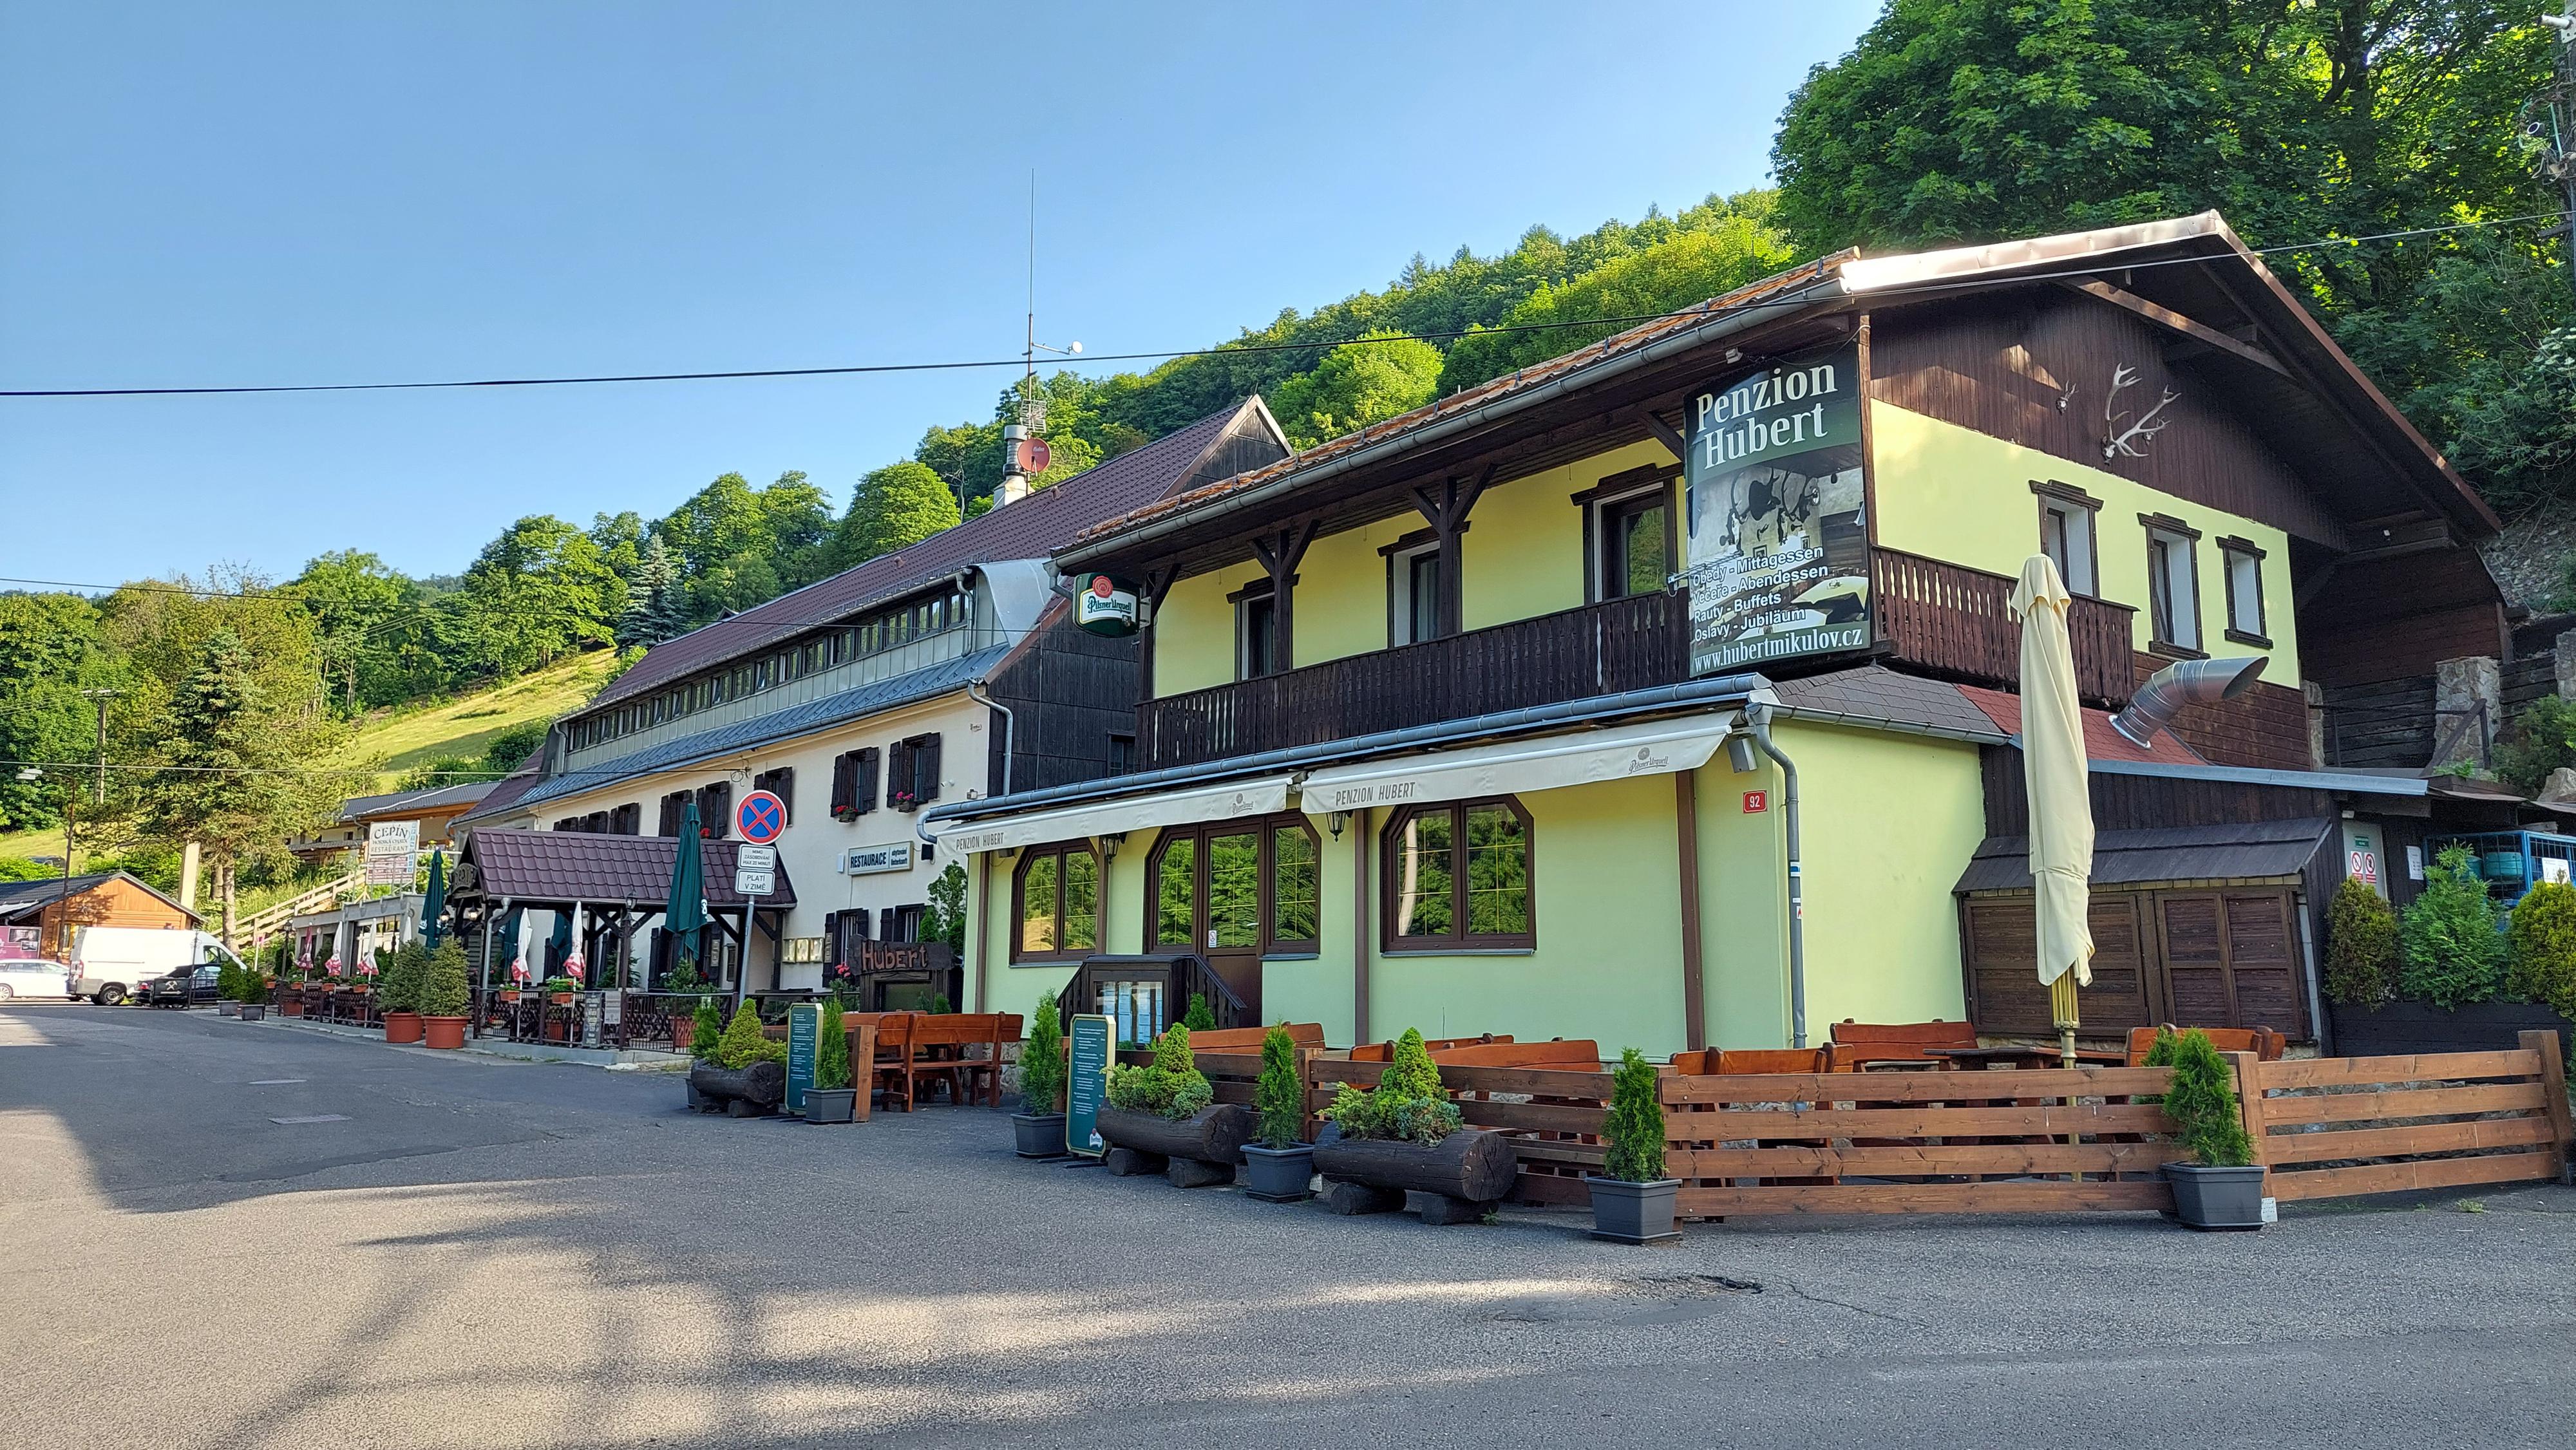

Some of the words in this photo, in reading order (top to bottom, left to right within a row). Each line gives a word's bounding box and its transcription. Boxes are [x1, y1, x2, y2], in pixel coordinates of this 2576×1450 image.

[1696, 364, 1838, 433] Penzion
[1704, 403, 1828, 469] Hubert
[1737, 547, 1823, 574] Mittagessen
[1693, 583, 1728, 605] Večeře
[1738, 566, 1828, 592] Abendessen
[1088, 596, 1112, 614] Pilsner
[1111, 598, 1132, 612] Urquell
[1694, 605, 1724, 624] Rauty
[1734, 592, 1781, 612] Buffets
[1694, 623, 1730, 642] Oslavy
[1741, 608, 1806, 630] Jubiläum
[1694, 628, 1862, 672] www.hubertmikulov.cz
[1629, 759, 1650, 775] Pilsner
[1336, 786, 1374, 806] PENZION
[1378, 782, 1416, 800] HUBERT
[1749, 795, 1761, 808] 92
[956, 836, 980, 851] PENZION
[983, 832, 1004, 847] HUBERT
[850, 852, 887, 869] RESTAURACE
